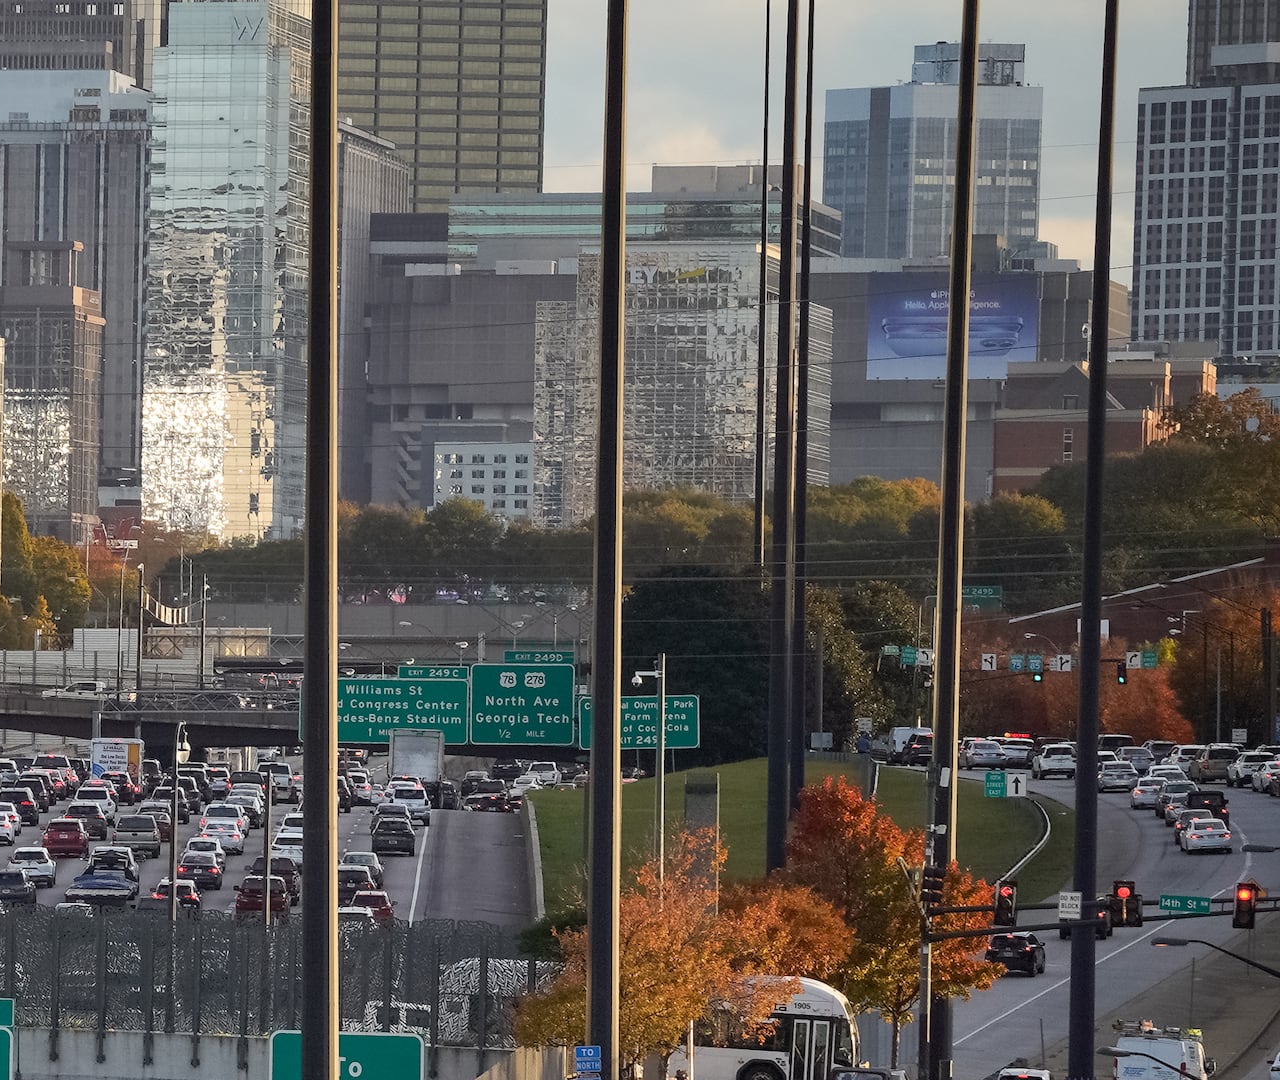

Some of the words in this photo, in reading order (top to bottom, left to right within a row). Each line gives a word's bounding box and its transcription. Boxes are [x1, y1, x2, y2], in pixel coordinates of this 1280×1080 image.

[630, 266, 659, 284] EY
[534, 653, 563, 662] 249D
[503, 675, 514, 684] 78
[526, 675, 544, 685] 278
[345, 684, 402, 695] Williams
[409, 685, 423, 696] St
[350, 699, 409, 711] Congress
[416, 700, 459, 710] Center
[485, 695, 525, 706] North
[533, 696, 560, 706] Ave
[673, 700, 694, 709] Park
[407, 714, 462, 724] Stadium
[475, 712, 529, 726] Georgia
[537, 713, 570, 723] Tech
[624, 713, 651, 721] Farm
[623, 724, 633, 733] of
[638, 724, 689, 733] Coc-Cola
[526, 730, 545, 738] MILE
[1162, 898, 1180, 908] 14th
[1187, 899, 1197, 909] St
[794, 1002, 811, 1010] 1905
[581, 1048, 594, 1057] TO
[576, 1060, 600, 1070] NORTH
